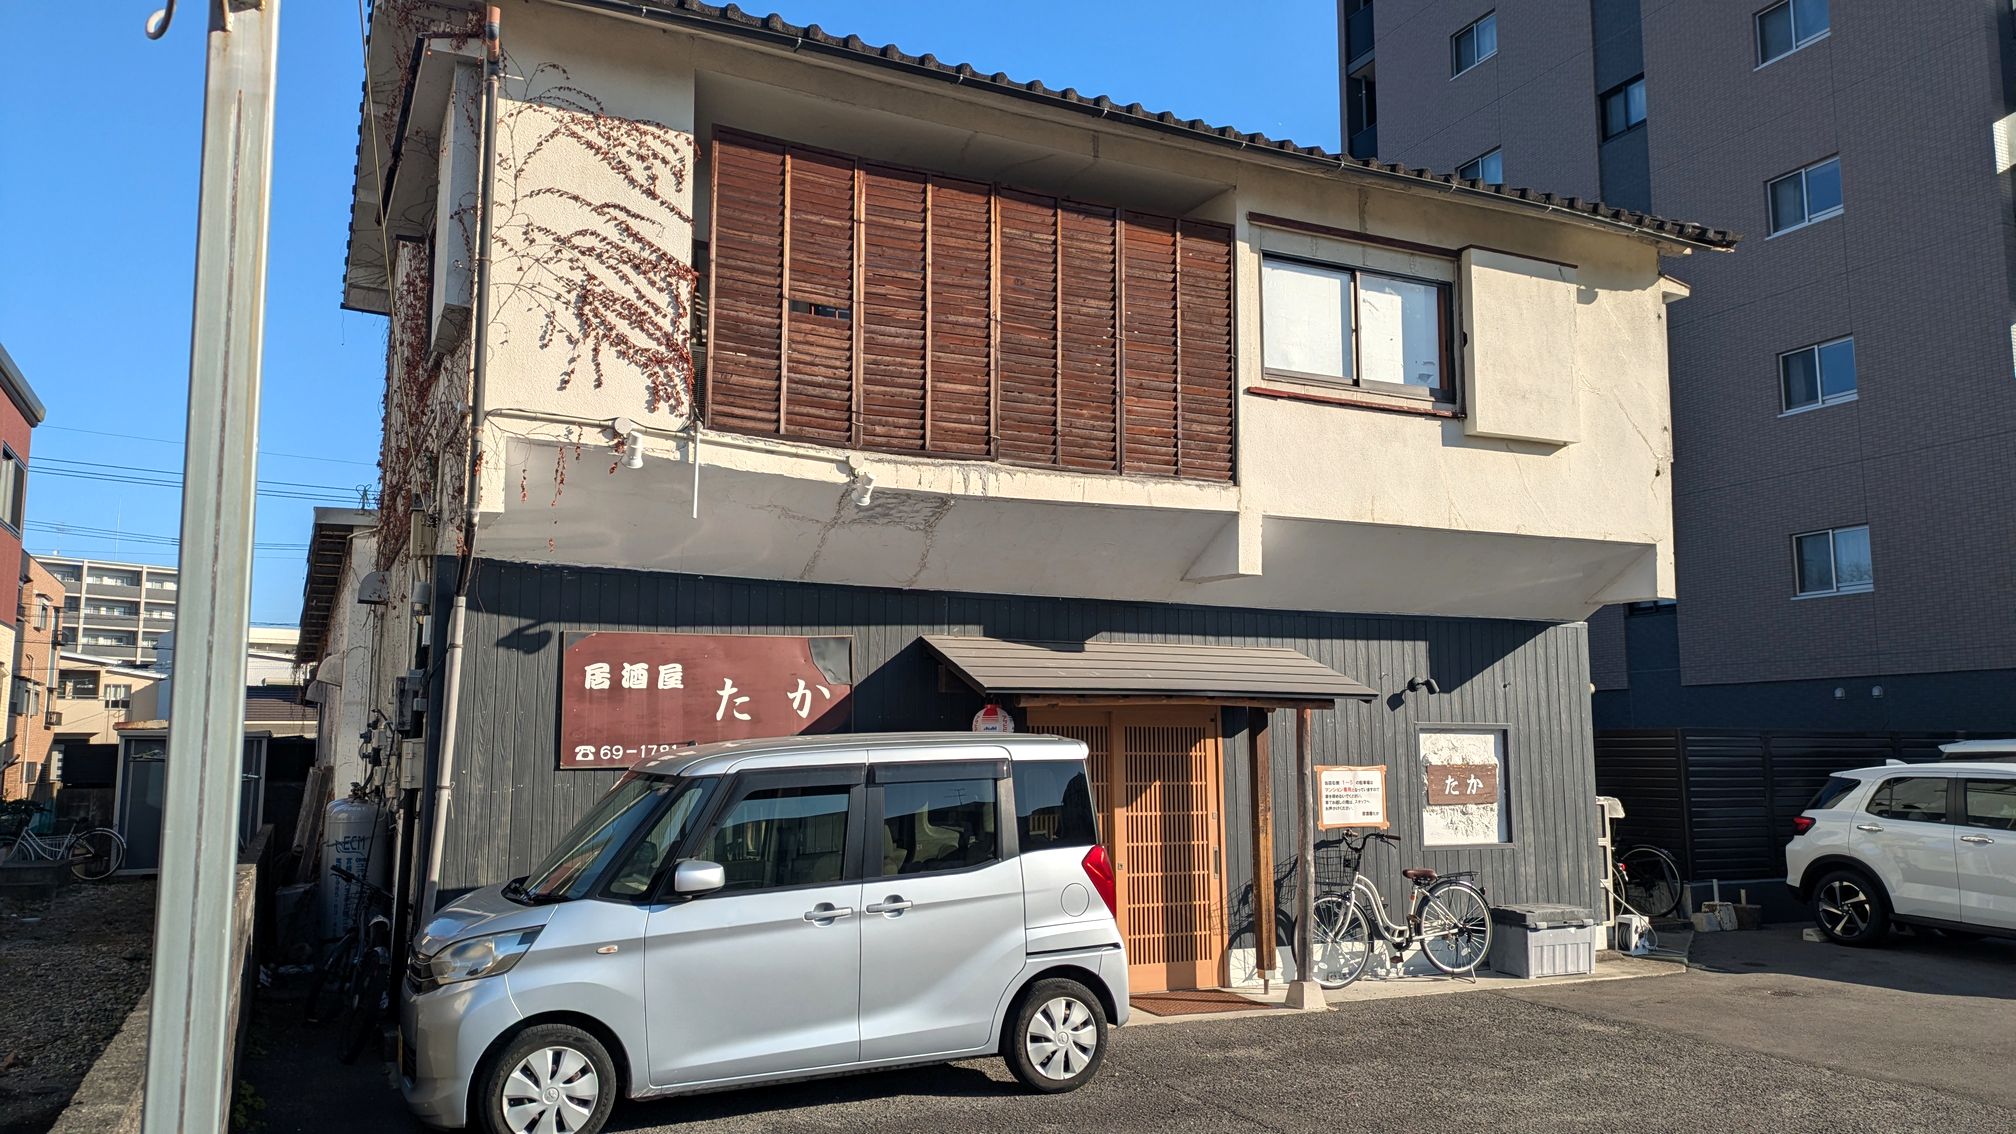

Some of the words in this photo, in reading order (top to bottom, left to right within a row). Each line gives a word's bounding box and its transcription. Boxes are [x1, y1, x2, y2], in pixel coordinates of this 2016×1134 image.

[584, 662, 684, 690] 居酒屋
[715, 677, 831, 721] たか
[1444, 774, 1484, 795] たか
